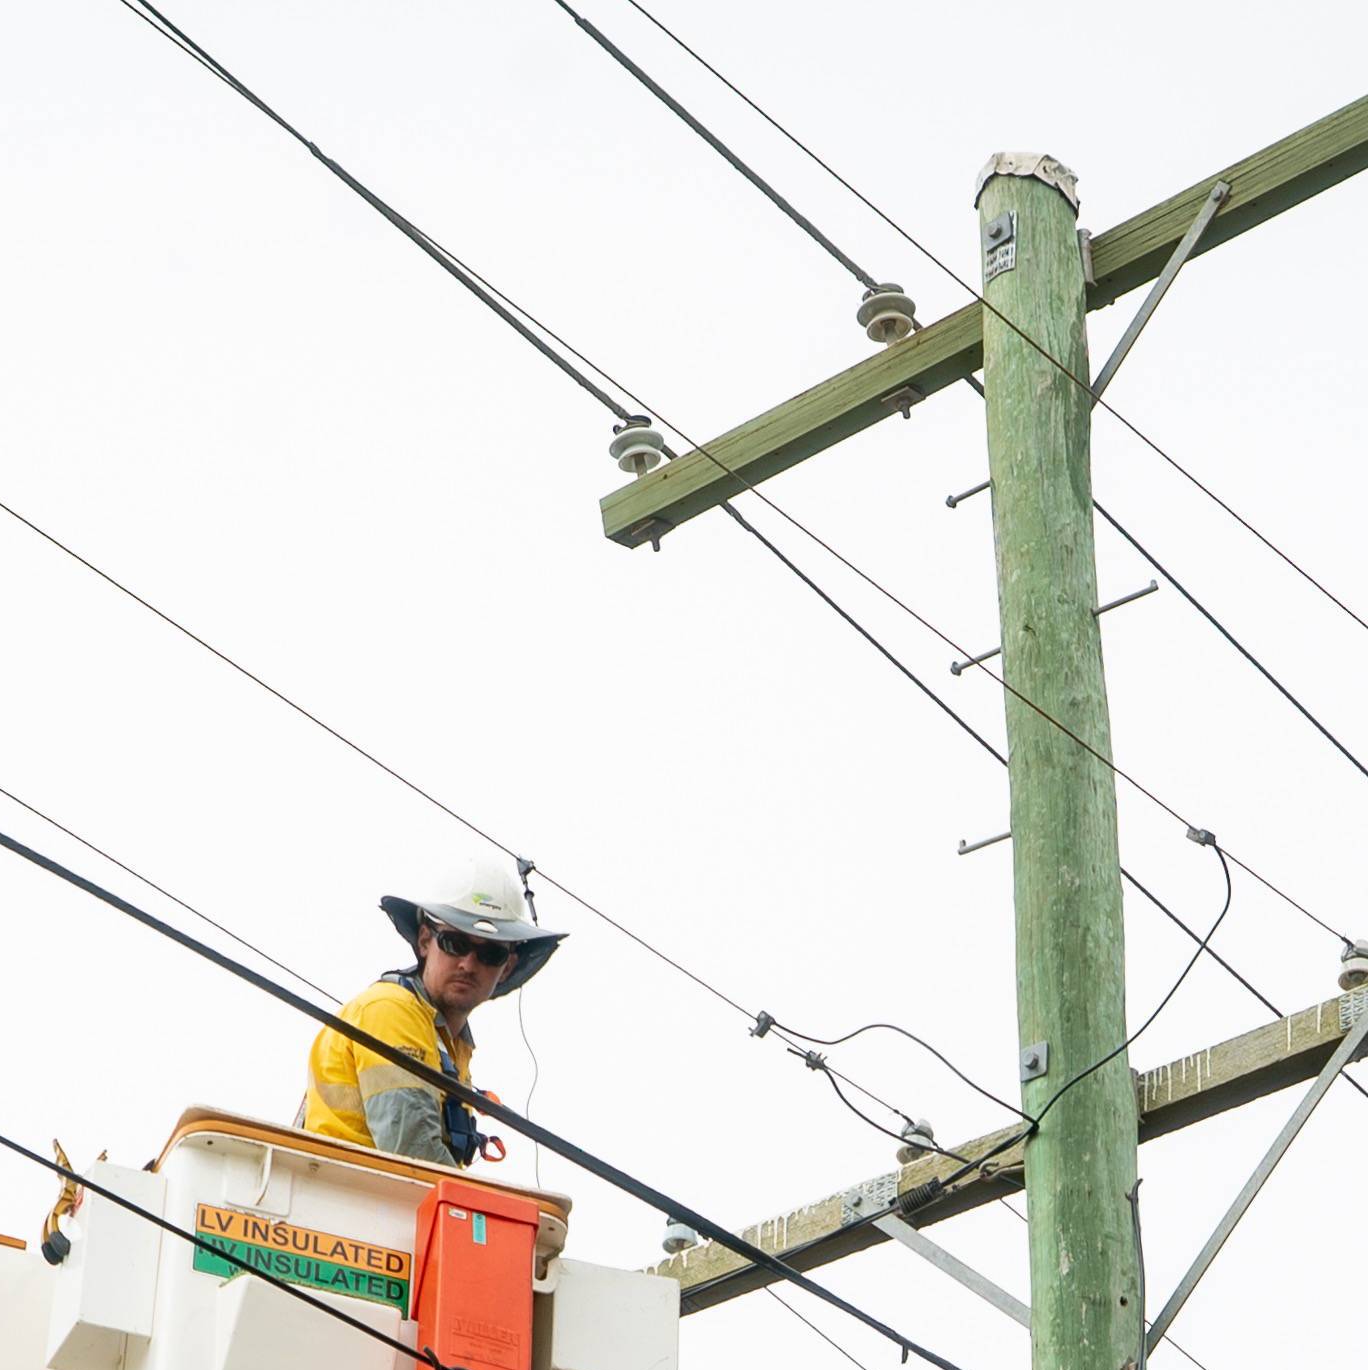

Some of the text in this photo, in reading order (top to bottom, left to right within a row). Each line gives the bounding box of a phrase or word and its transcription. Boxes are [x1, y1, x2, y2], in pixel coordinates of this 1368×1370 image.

[200, 1209, 404, 1273] LV INSULATED
[245, 1246, 404, 1300] INSULATED
